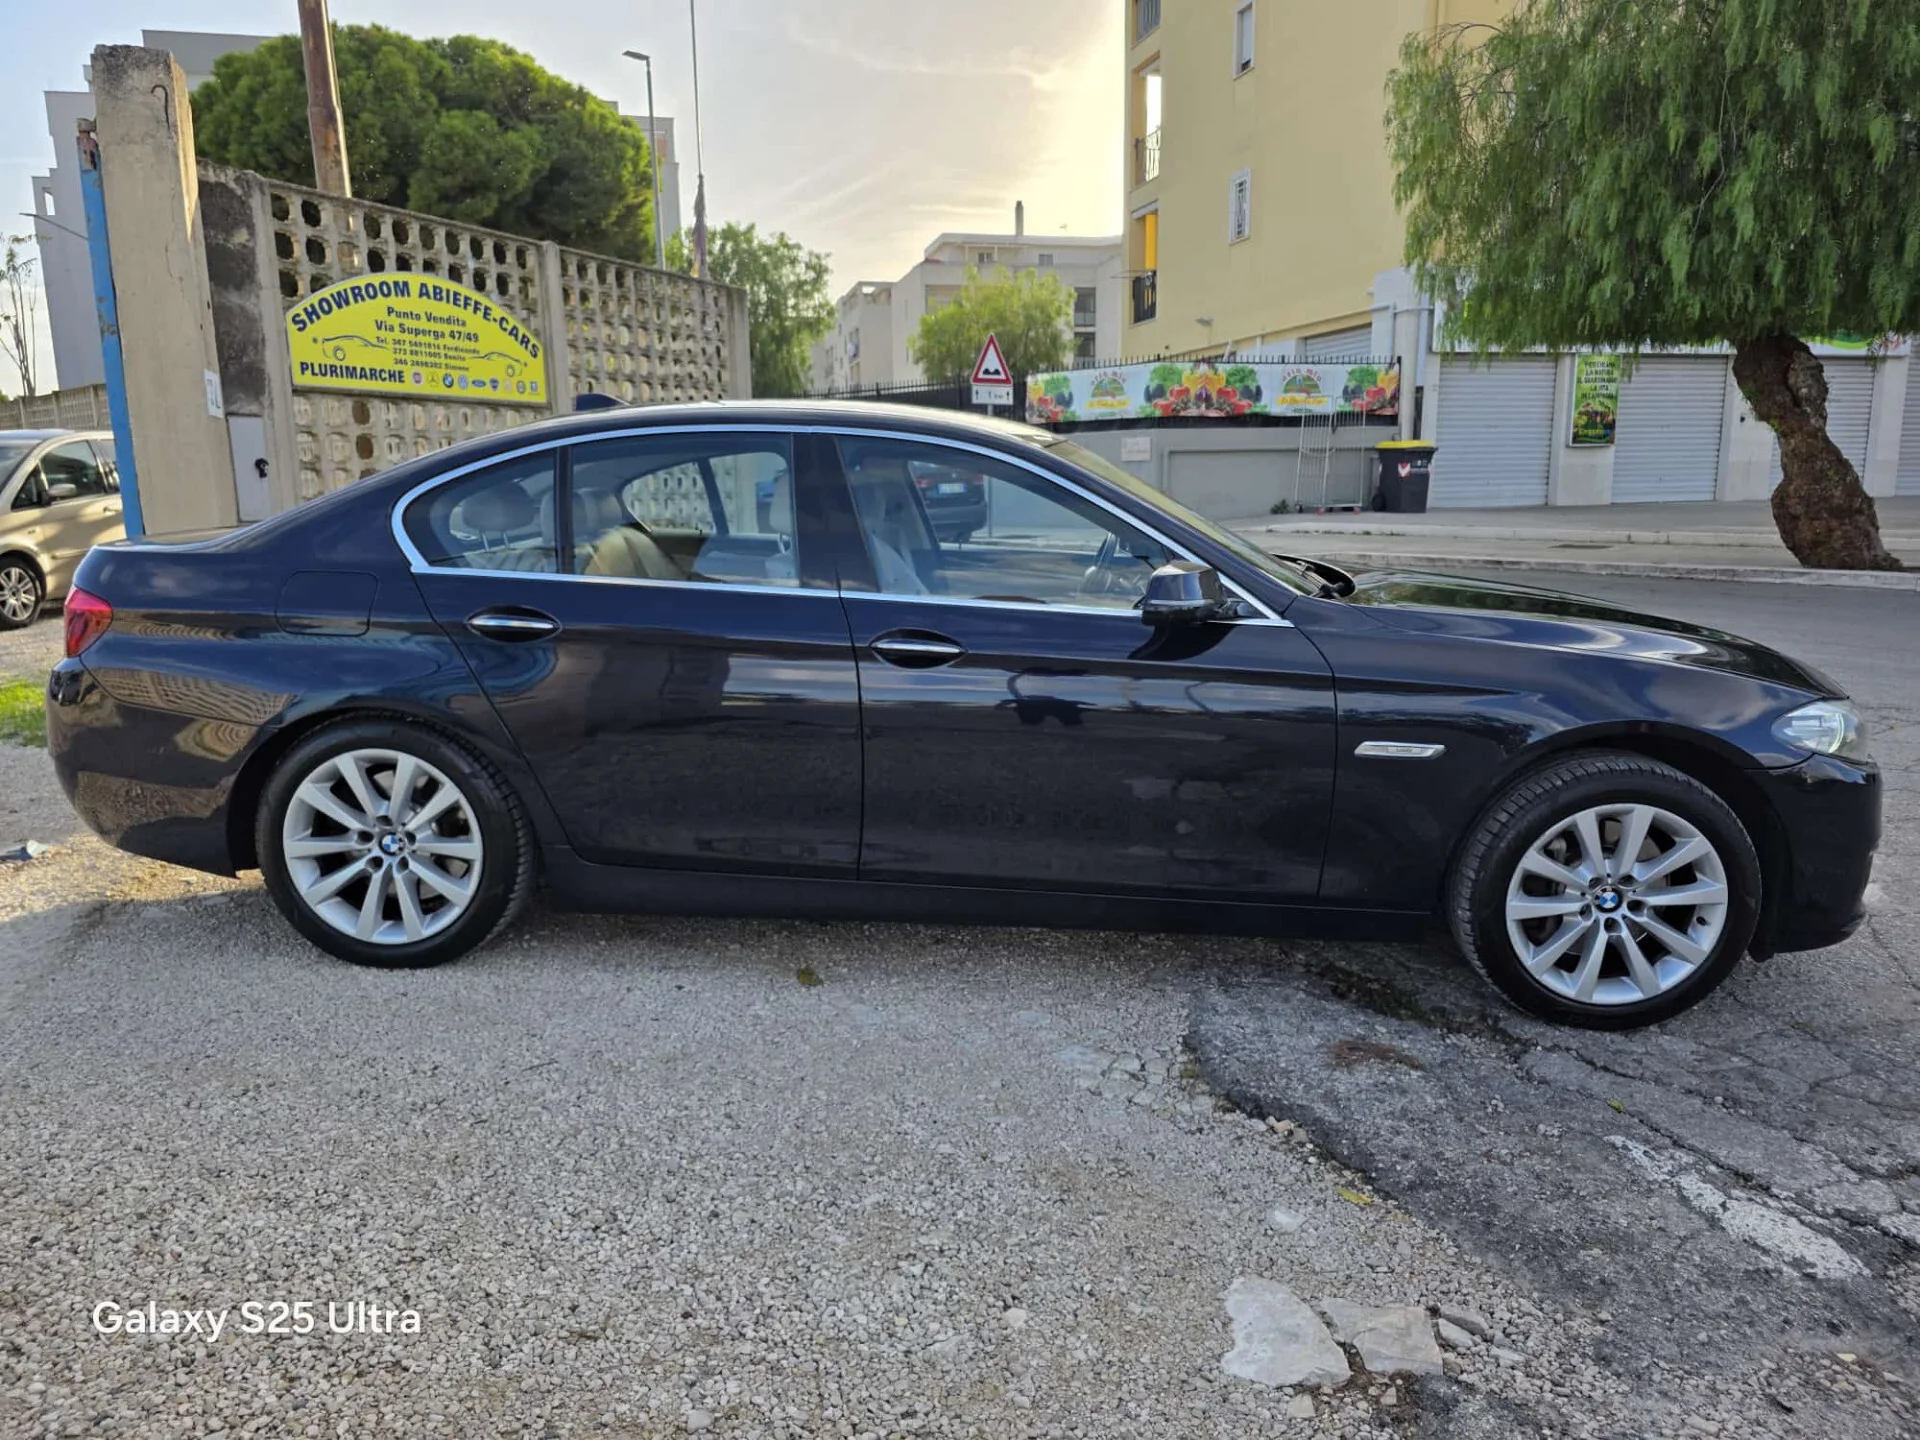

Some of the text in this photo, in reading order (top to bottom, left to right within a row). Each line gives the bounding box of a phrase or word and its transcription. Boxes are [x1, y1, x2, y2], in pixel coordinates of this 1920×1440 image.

[291, 280, 539, 359] SHOWROOM ABIEFFE-CARS
[387, 306, 467, 328] Punto Vendita
[375, 319, 480, 343] Via Superga 47/49
[300, 361, 405, 384] PLURIMARCHE
